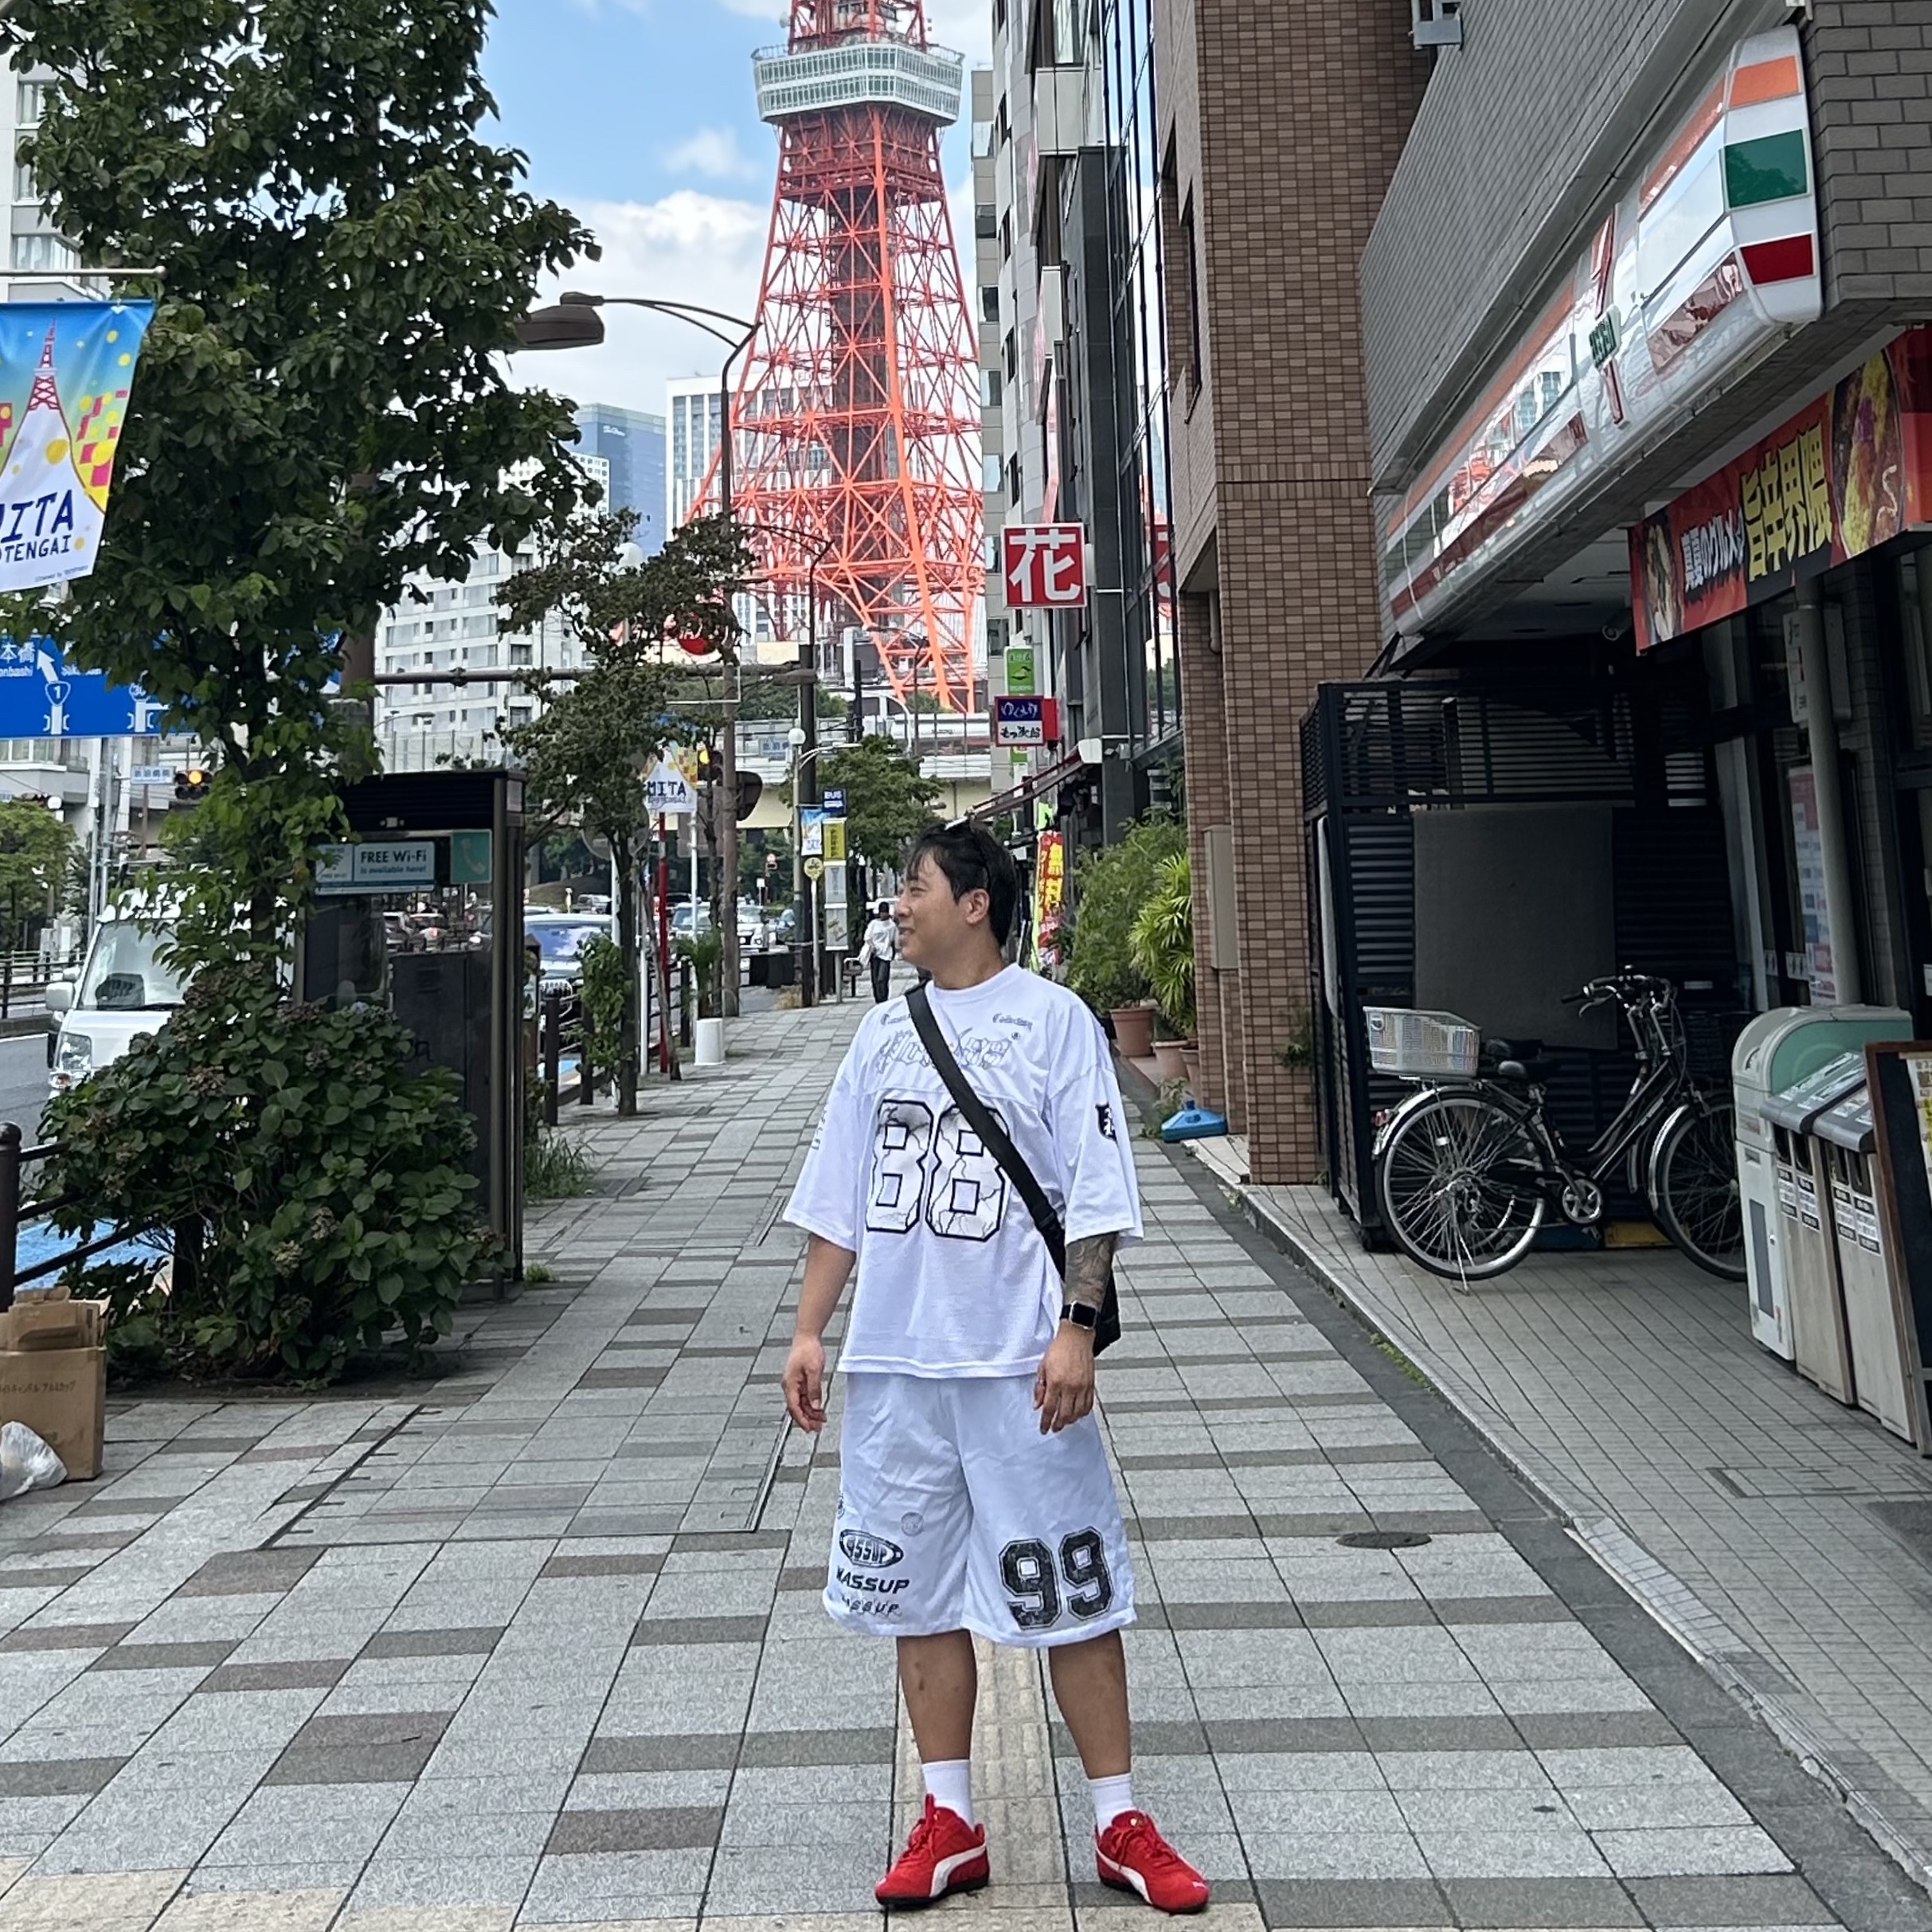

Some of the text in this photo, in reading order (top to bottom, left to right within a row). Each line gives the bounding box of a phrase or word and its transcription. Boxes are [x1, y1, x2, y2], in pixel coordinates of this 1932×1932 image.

[0, 489, 73, 543] ITA
[0, 534, 72, 563] TENGAI
[1009, 529, 1081, 602] 花
[54, 686, 61, 699] 1
[647, 781, 686, 796] MITA
[361, 850, 427, 863] FREE Wi-Fi
[999, 1525, 1114, 1630] 99
